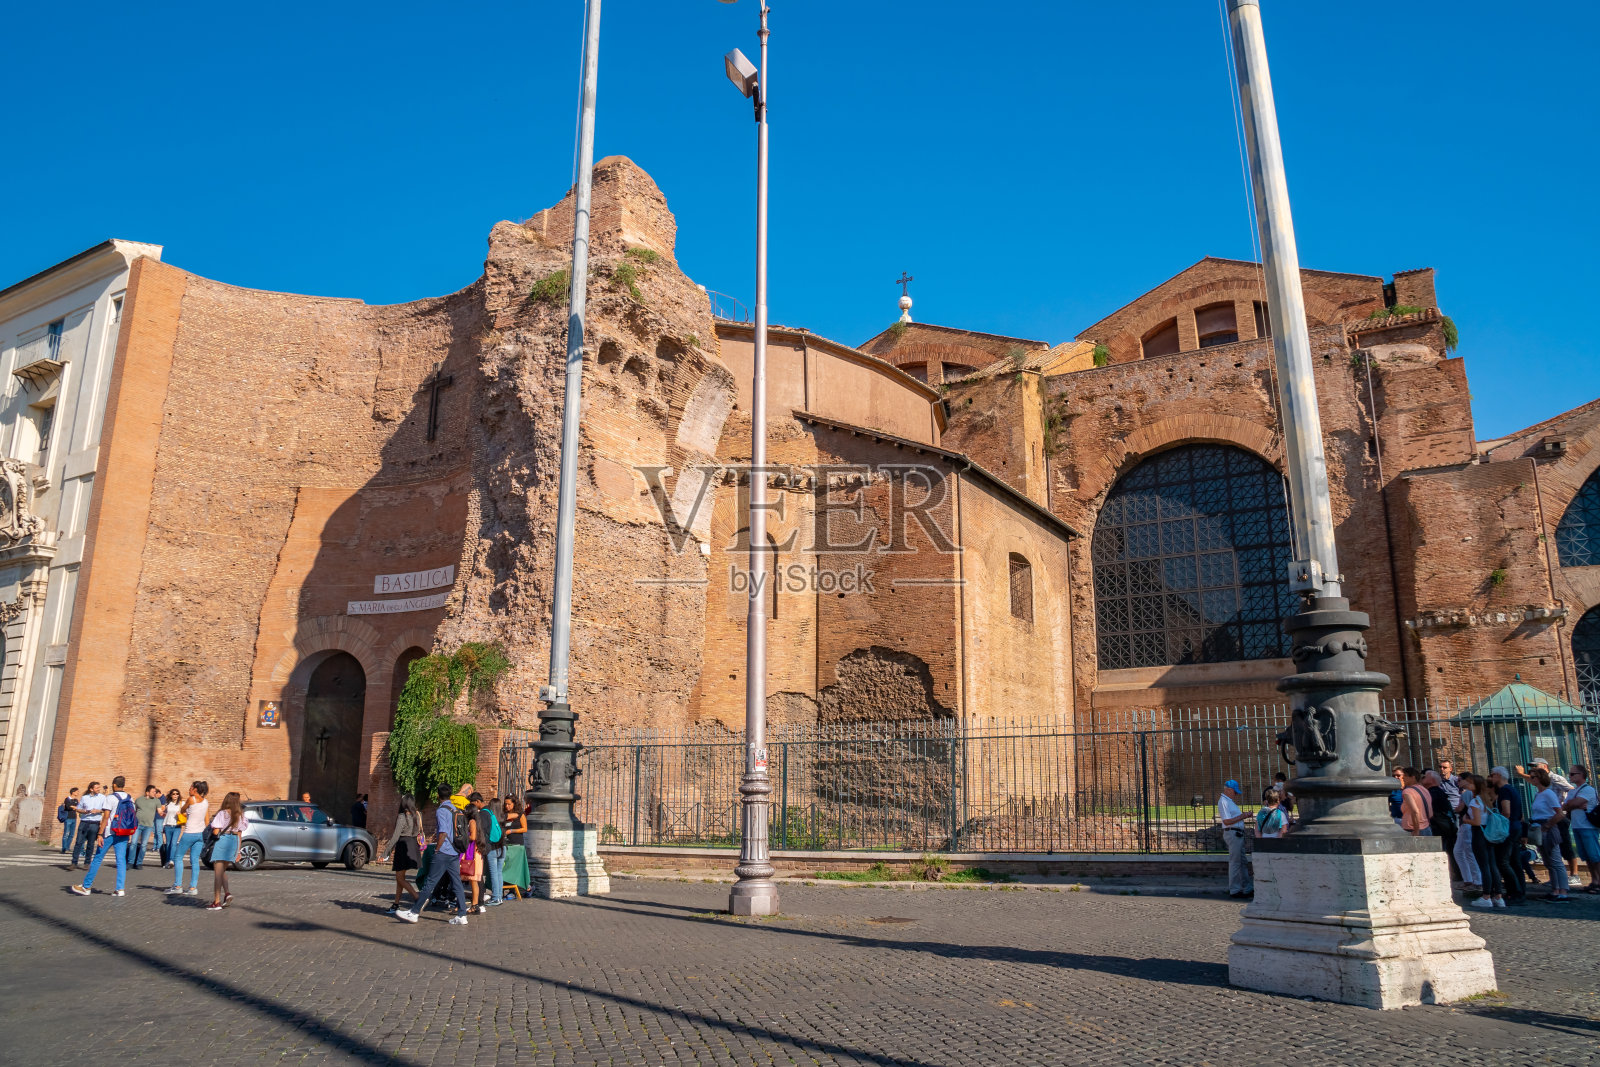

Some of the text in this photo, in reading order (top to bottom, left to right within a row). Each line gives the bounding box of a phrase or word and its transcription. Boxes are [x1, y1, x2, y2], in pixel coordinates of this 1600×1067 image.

[382, 570, 448, 592] BASILICA
[360, 603, 385, 612] MARIA
[404, 597, 431, 609] ANGELI
